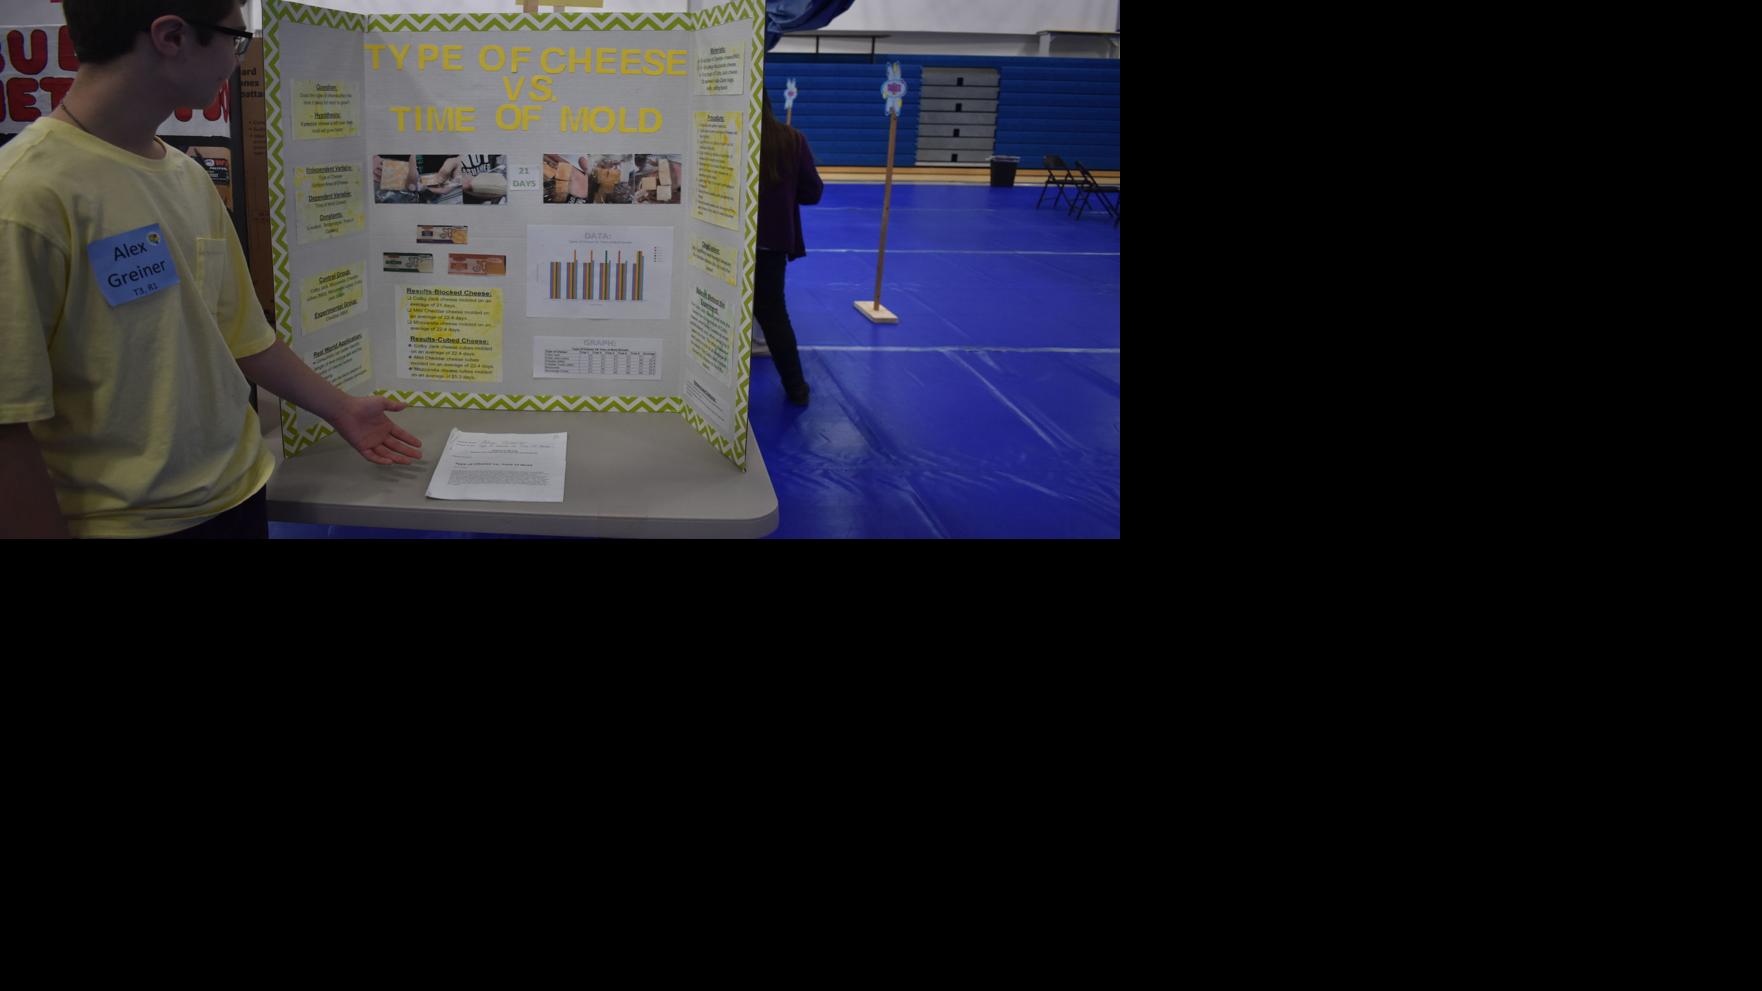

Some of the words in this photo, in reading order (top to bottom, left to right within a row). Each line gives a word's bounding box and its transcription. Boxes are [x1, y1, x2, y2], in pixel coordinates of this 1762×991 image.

[364, 43, 464, 71] TYPE
[479, 44, 531, 73] OF
[540, 47, 688, 76] CHEESE
[503, 75, 558, 102] VS.
[389, 106, 476, 132] TIME
[496, 104, 544, 131] OF
[560, 106, 663, 133] MOLD
[114, 242, 147, 262] Alex
[108, 260, 166, 288] Greiner
